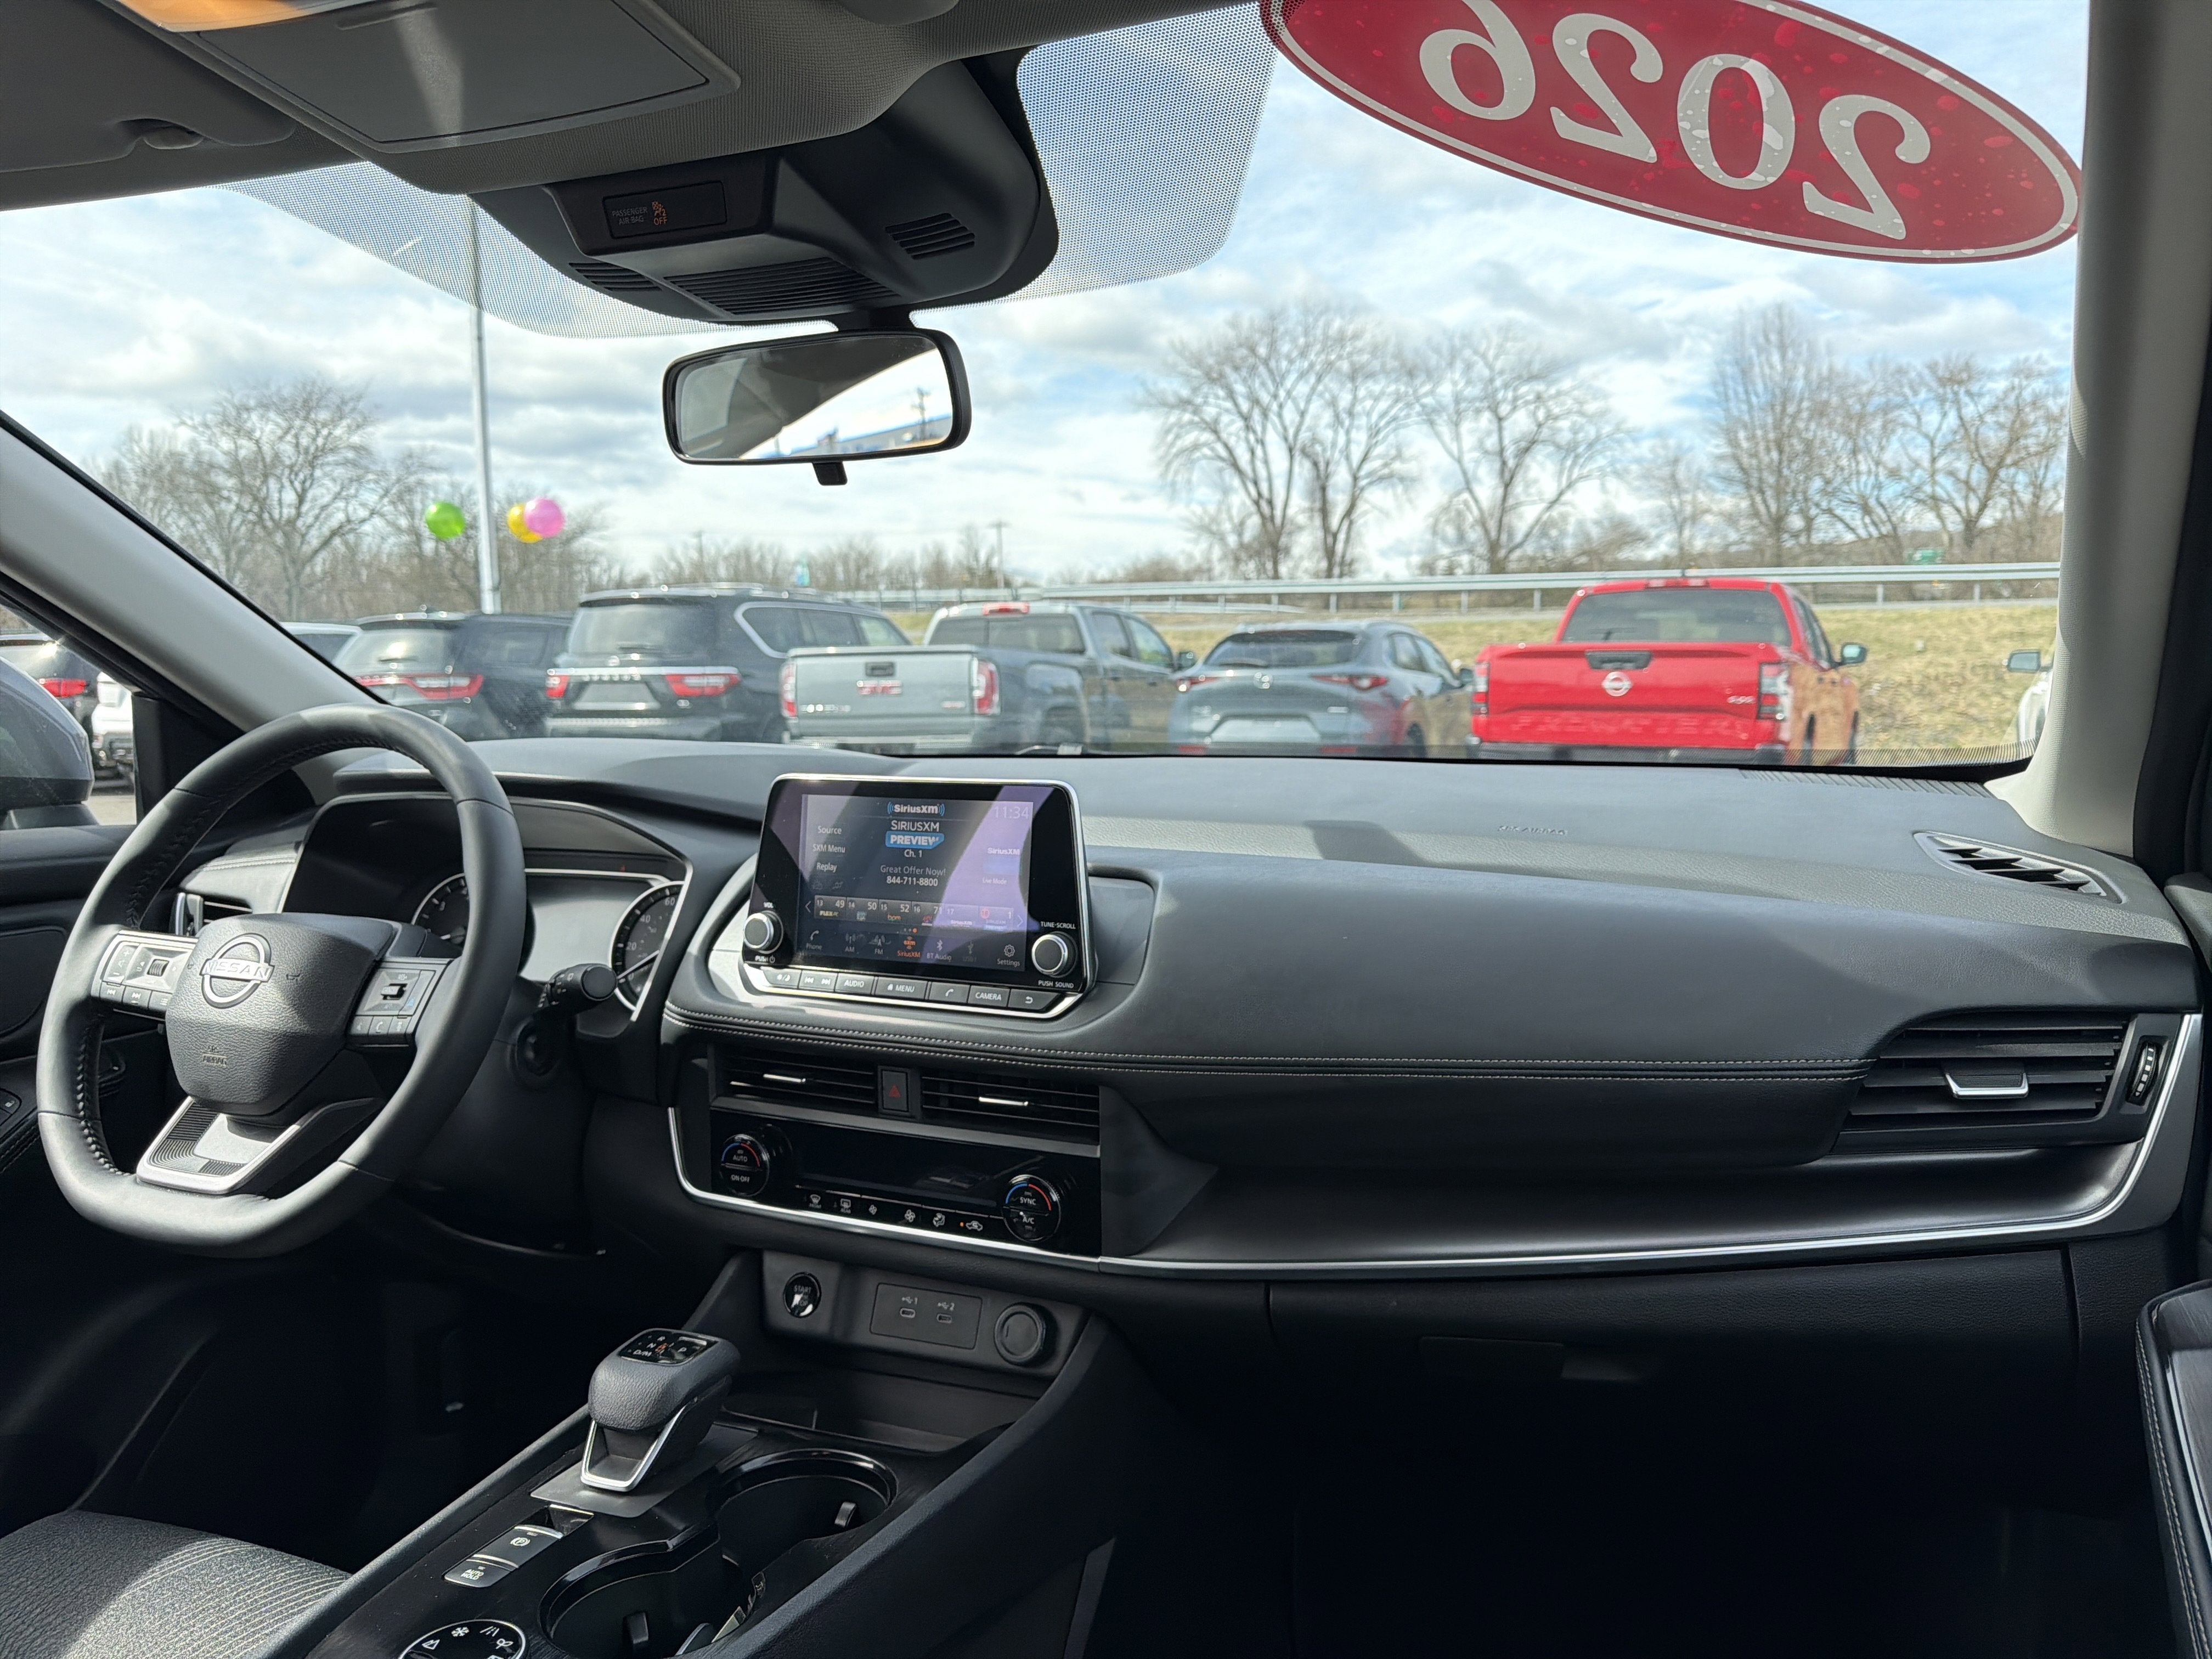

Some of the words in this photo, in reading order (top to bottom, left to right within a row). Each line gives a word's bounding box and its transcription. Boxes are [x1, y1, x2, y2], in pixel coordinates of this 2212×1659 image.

[612, 206, 648, 217] PASSENGER
[619, 217, 629, 225] AIR
[631, 215, 644, 223] BAG
[653, 217, 668, 225] OFF
[994, 806, 1029, 819] 11:34
[817, 826, 842, 834] Source
[891, 820, 940, 832] SIRIUSXM
[890, 834, 939, 845] PREVIEW
[812, 844, 827, 852] SXM
[828, 845, 845, 853] Menu
[904, 849, 916, 857] Ch.
[817, 862, 837, 873] Replay
[880, 865, 901, 873] Great
[904, 866, 923, 875] Offer
[926, 867, 946, 877] Now!
[887, 876, 938, 887] 844-711-8800
[665, 897, 675, 906] 60
[836, 900, 845, 909] 49
[867, 901, 877, 911] 50
[900, 904, 910, 912] 52
[640, 915, 651, 923] 40
[626, 941, 637, 951] 20
[997, 958, 1020, 967] Settings
[205, 961, 272, 979] NISSAN
[895, 984, 915, 993] MENU
[975, 992, 1002, 1001] CAMERA
[202, 1055, 227, 1065] AIRBAG
[1020, 1197, 1036, 1205] SYNC
[794, 1285, 811, 1293] START
[949, 1302, 955, 1311] 2
